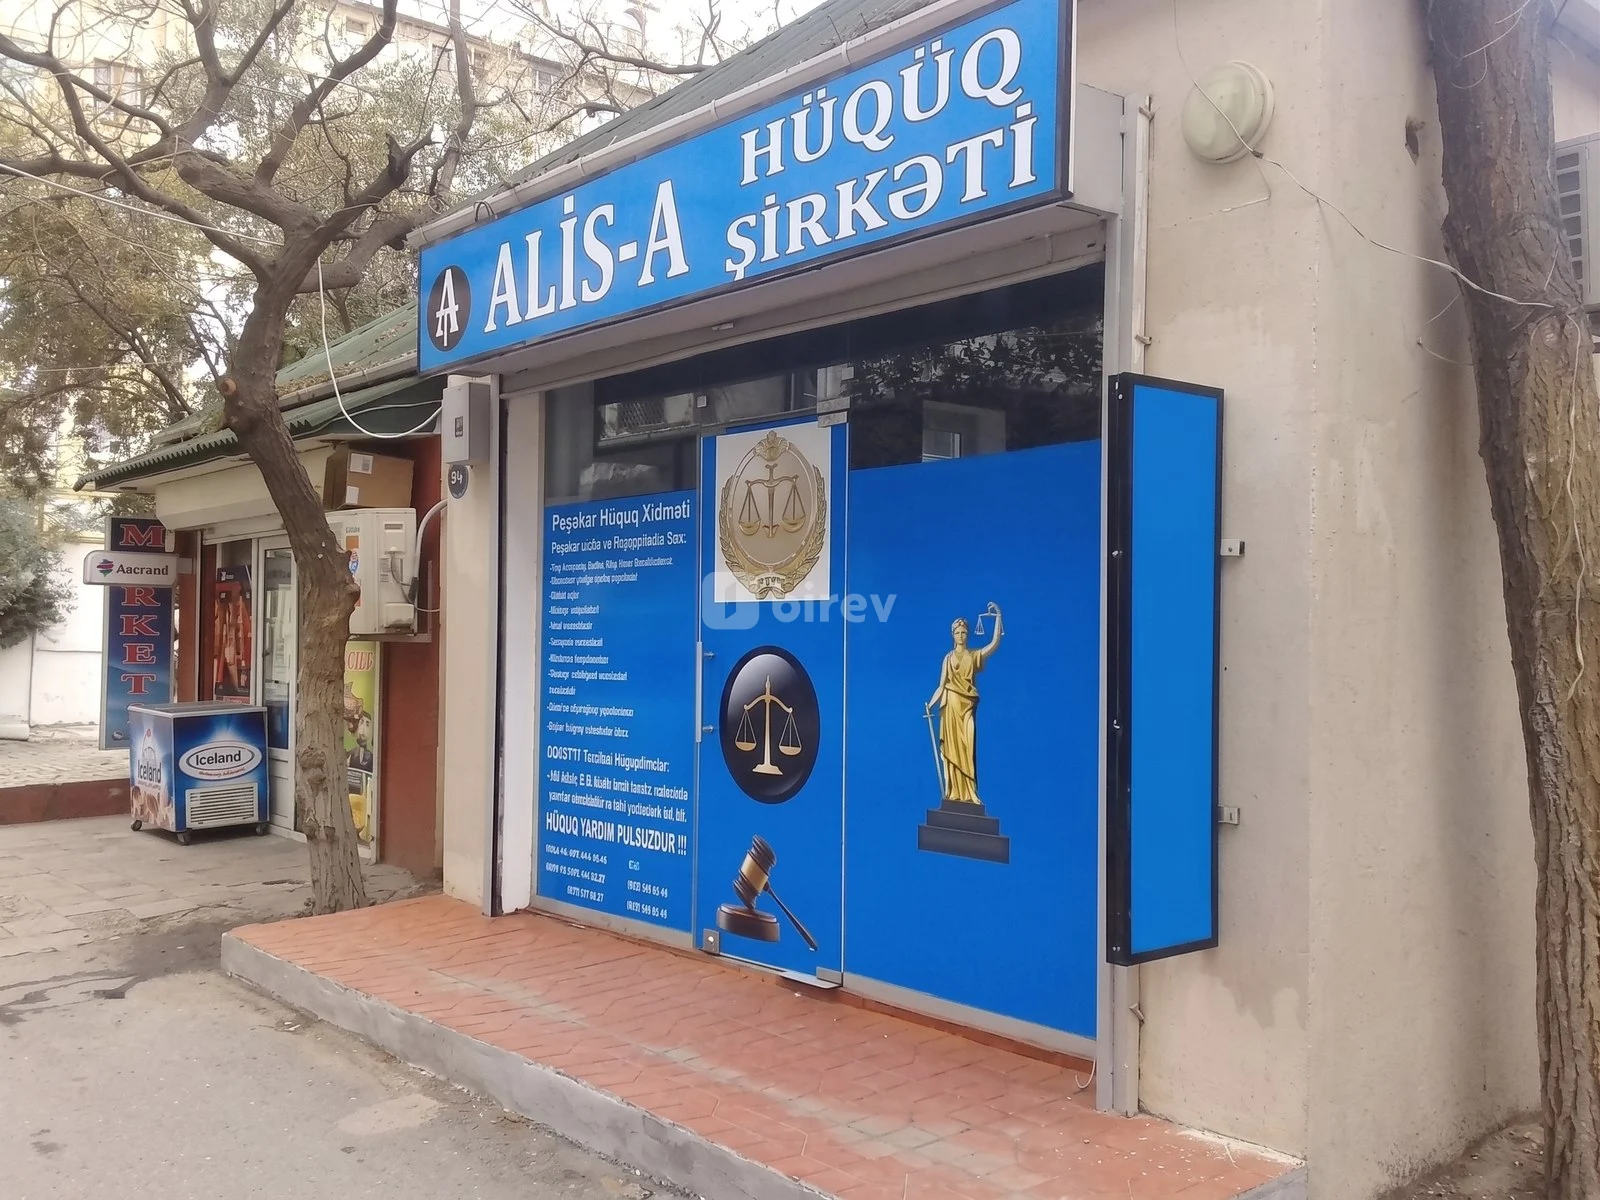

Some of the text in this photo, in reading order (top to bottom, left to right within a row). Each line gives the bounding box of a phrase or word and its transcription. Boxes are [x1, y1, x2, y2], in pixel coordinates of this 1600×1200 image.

[740, 28, 1023, 187] HÜQÜQ
[725, 102, 1038, 282] ŞİRKƏTİ
[484, 178, 690, 333] ALİS-A
[552, 499, 690, 534] Peşəkar Hüquq Xidməti
[137, 759, 162, 784] Iceland
[196, 750, 241, 766] Iceland
[545, 809, 579, 836] HÜQUQ
[580, 817, 615, 844] YARDIM
[617, 823, 676, 854] PULSUZDUR
[677, 834, 687, 856] !!!
